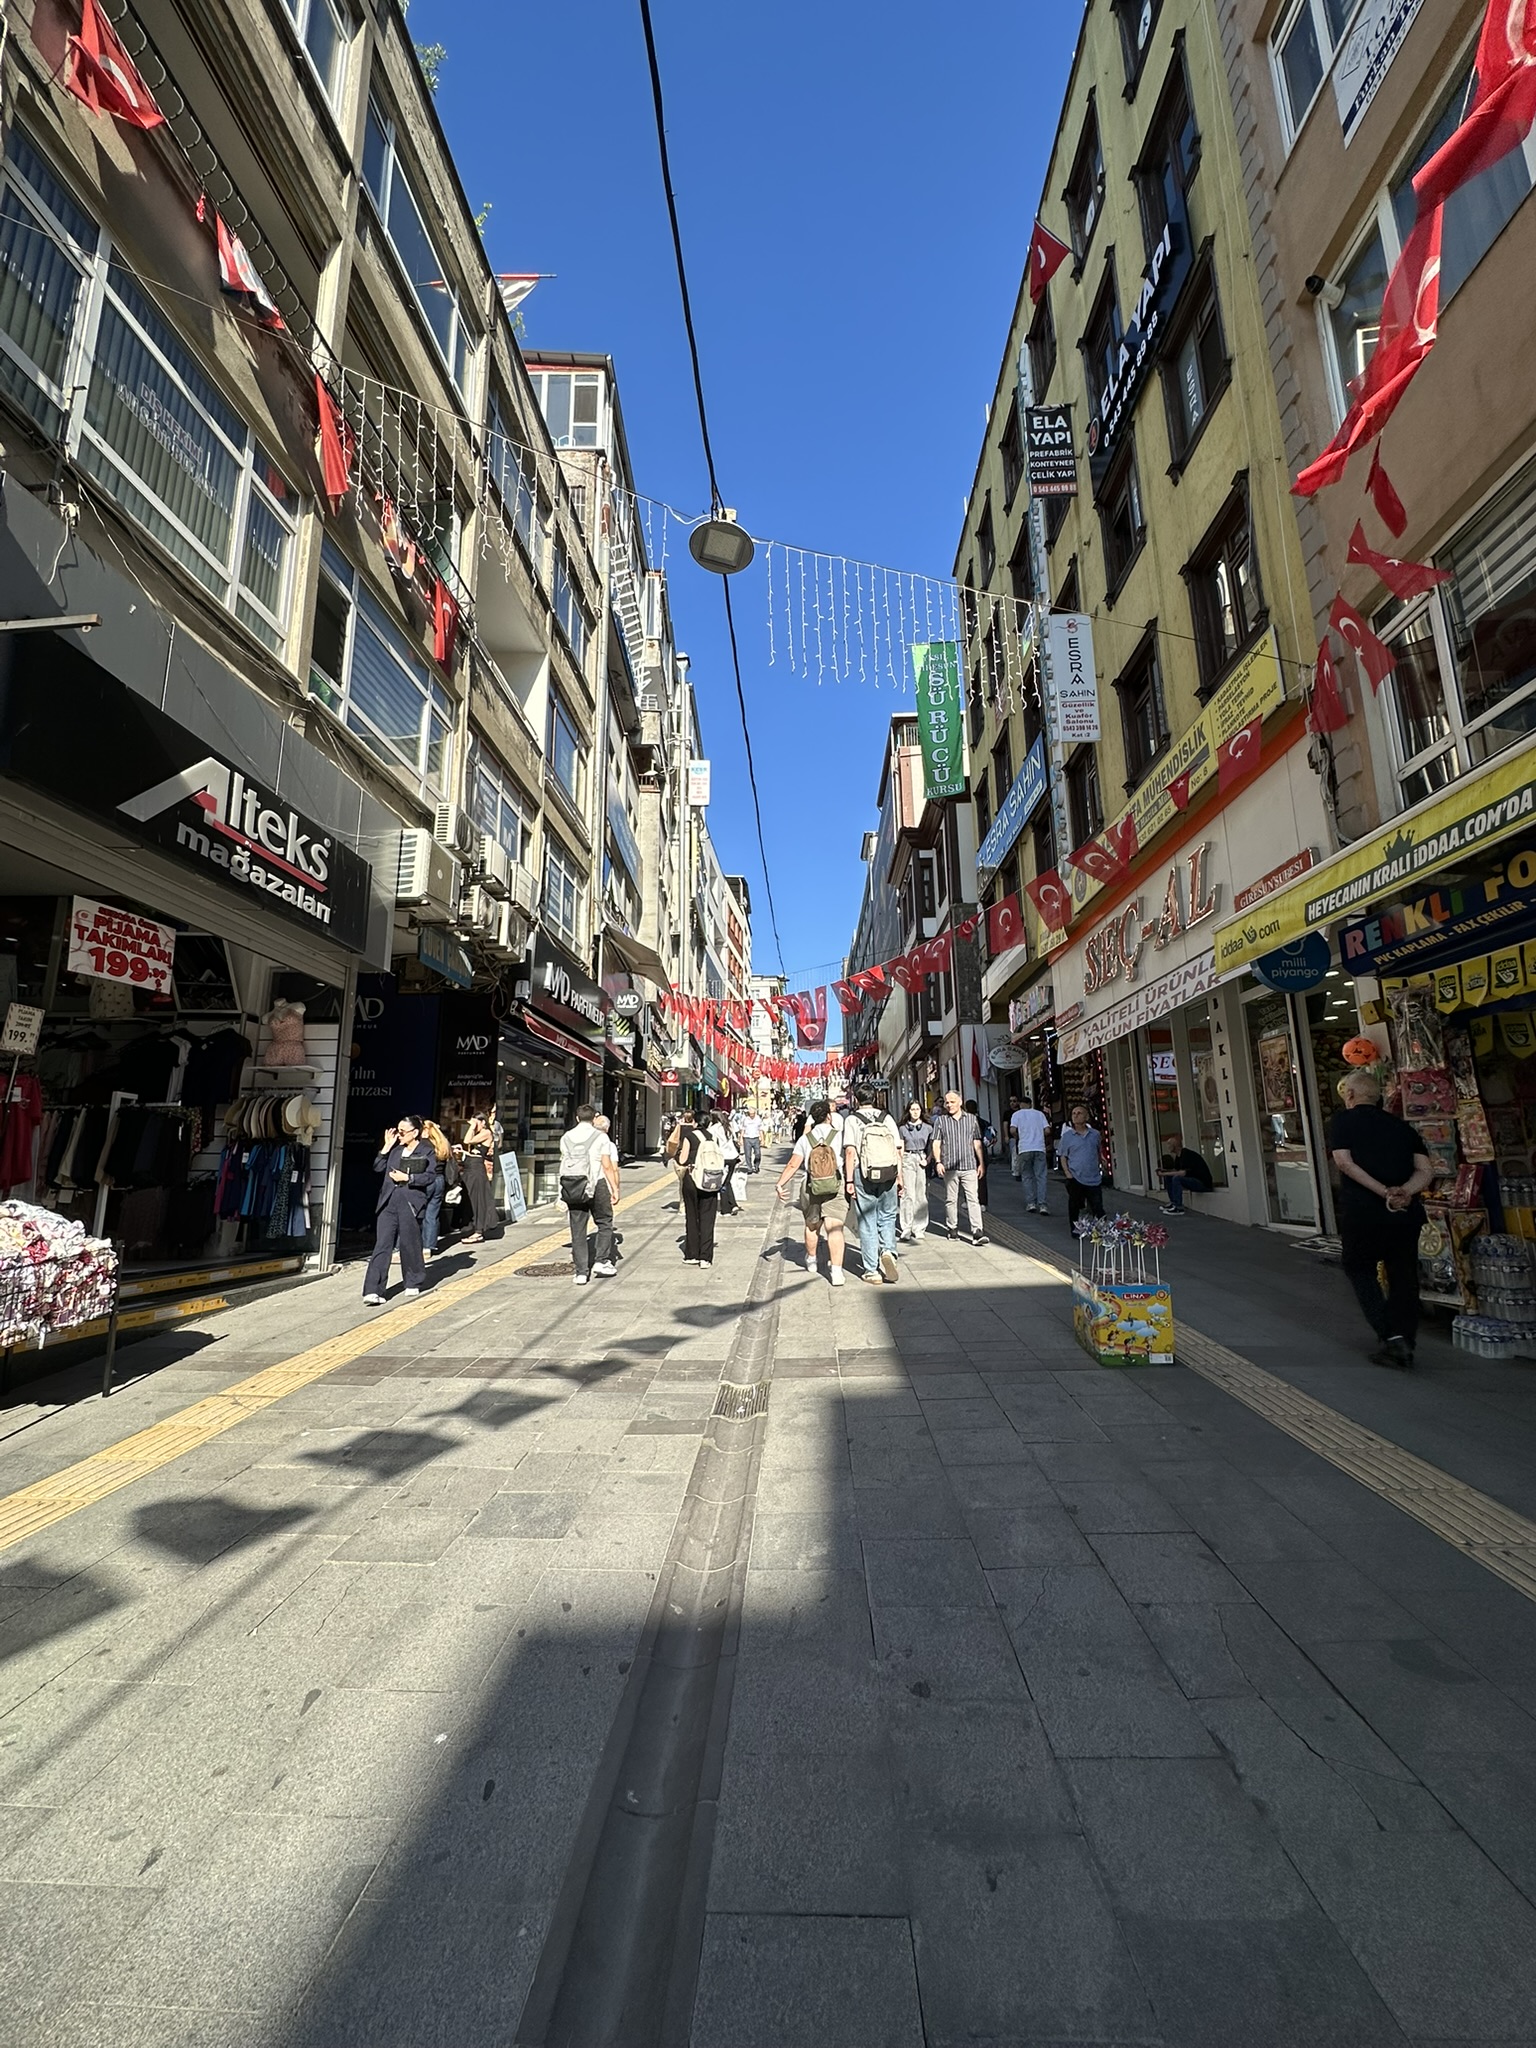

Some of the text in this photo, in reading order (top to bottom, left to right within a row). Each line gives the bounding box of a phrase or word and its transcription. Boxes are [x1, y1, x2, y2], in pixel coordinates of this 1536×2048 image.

[1100, 223, 1171, 422] ELA YAPI
[1030, 431, 1072, 446] YAPI
[1033, 415, 1068, 430] ELA
[1104, 433, 1110, 447] 0
[1109, 400, 1122, 435] 543
[1029, 448, 1073, 458] PREFABRİK
[1030, 459, 1075, 468] KONTEYNER
[1031, 470, 1076, 480] ÇELİK YAPI
[1068, 637, 1085, 685] ESRA
[1259, 681, 1278, 705] PROJE
[928, 671, 951, 783] SÜRÜCÜ
[1142, 721, 1206, 808] MÜHENDİSLİK
[926, 782, 963, 797] KURSU
[116, 757, 330, 882] Alteks
[986, 809, 1010, 862] ESRA
[176, 822, 331, 924] mağazaları
[1307, 878, 1371, 923] HEYECANIN
[1372, 853, 1411, 890] KRALI
[93, 914, 161, 948] PİJAMA
[1084, 842, 1220, 996] SEÇ-AL
[1220, 919, 1281, 960] iddaa com
[1373, 900, 1528, 966] PVC KAPLAMA FAX ÇEKİLİR
[74, 923, 173, 966] TAKIMLARI
[1281, 957, 1306, 967] milli
[1271, 968, 1319, 979] piyango
[543, 961, 570, 1005] MAD
[569, 988, 605, 1029] PARFUMEUR
[616, 993, 639, 1006] MAD
[1083, 994, 1141, 1039] KALİTELİ
[1087, 1020, 1132, 1049] UYGUN
[456, 1034, 489, 1051] MAD
[1149, 1056, 1176, 1069] SE
